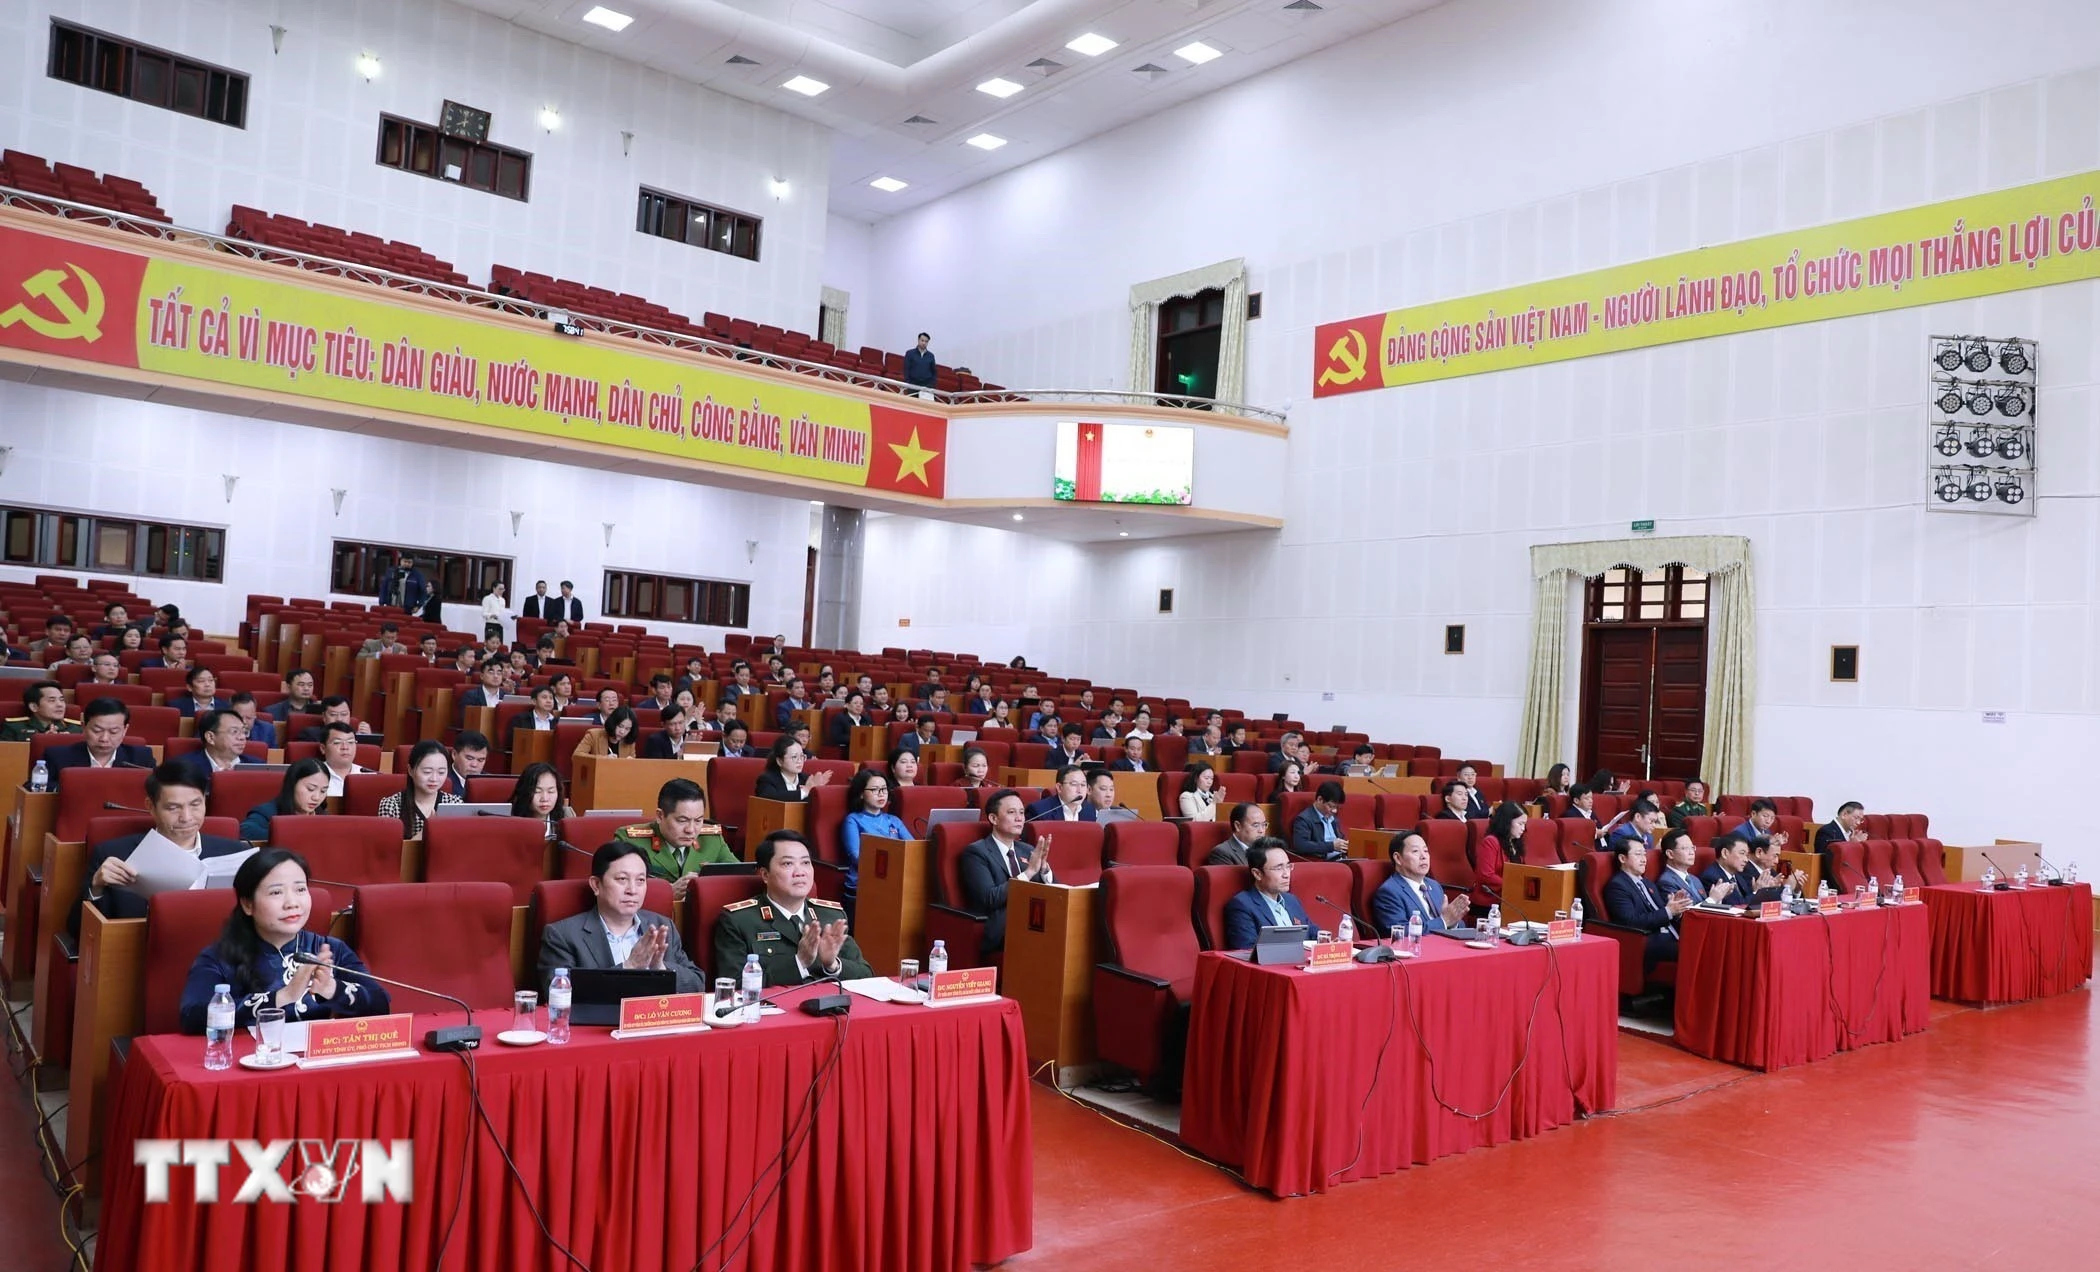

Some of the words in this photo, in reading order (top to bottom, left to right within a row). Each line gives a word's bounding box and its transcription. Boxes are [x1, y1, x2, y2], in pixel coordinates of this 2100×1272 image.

[1387, 326, 1426, 366] ĐẢNG
[1430, 322, 1471, 364] CỘNG
[1474, 310, 1507, 352] SẢN
[1511, 305, 1546, 349] VIỆT
[1549, 302, 1588, 338] NAM
[1604, 281, 1661, 329] NGƯỜI
[1665, 277, 1716, 318] LÃNH
[1720, 270, 1768, 315] ĐẠO,
[1772, 249, 1799, 301] TỔ
[1803, 248, 1862, 296] CHỨC
[1868, 243, 1913, 291] MỌI
[1920, 219, 2002, 278] THẮNG
[2008, 215, 2051, 269] LỢI
[2057, 195, 2100, 256] CỦ
[149, 285, 193, 350] TẤT
[199, 296, 231, 357] CẢ
[238, 308, 260, 362] VÌ
[265, 320, 317, 379] MỤC
[324, 326, 376, 382] TIÊU:
[381, 336, 425, 391] DÂN
[429, 347, 481, 406] GIÀU,
[486, 359, 539, 409] NƯỚC
[543, 372, 602, 424] MẠNH,
[607, 379, 645, 428] DÂN
[648, 384, 685, 440] CHỦ,
[691, 395, 735, 443] CÔNG
[739, 398, 784, 456] BẰNG,
[790, 413, 819, 459] VĂN
[822, 426, 867, 466] MINH!
[363, 1033, 378, 1042] THỊ
